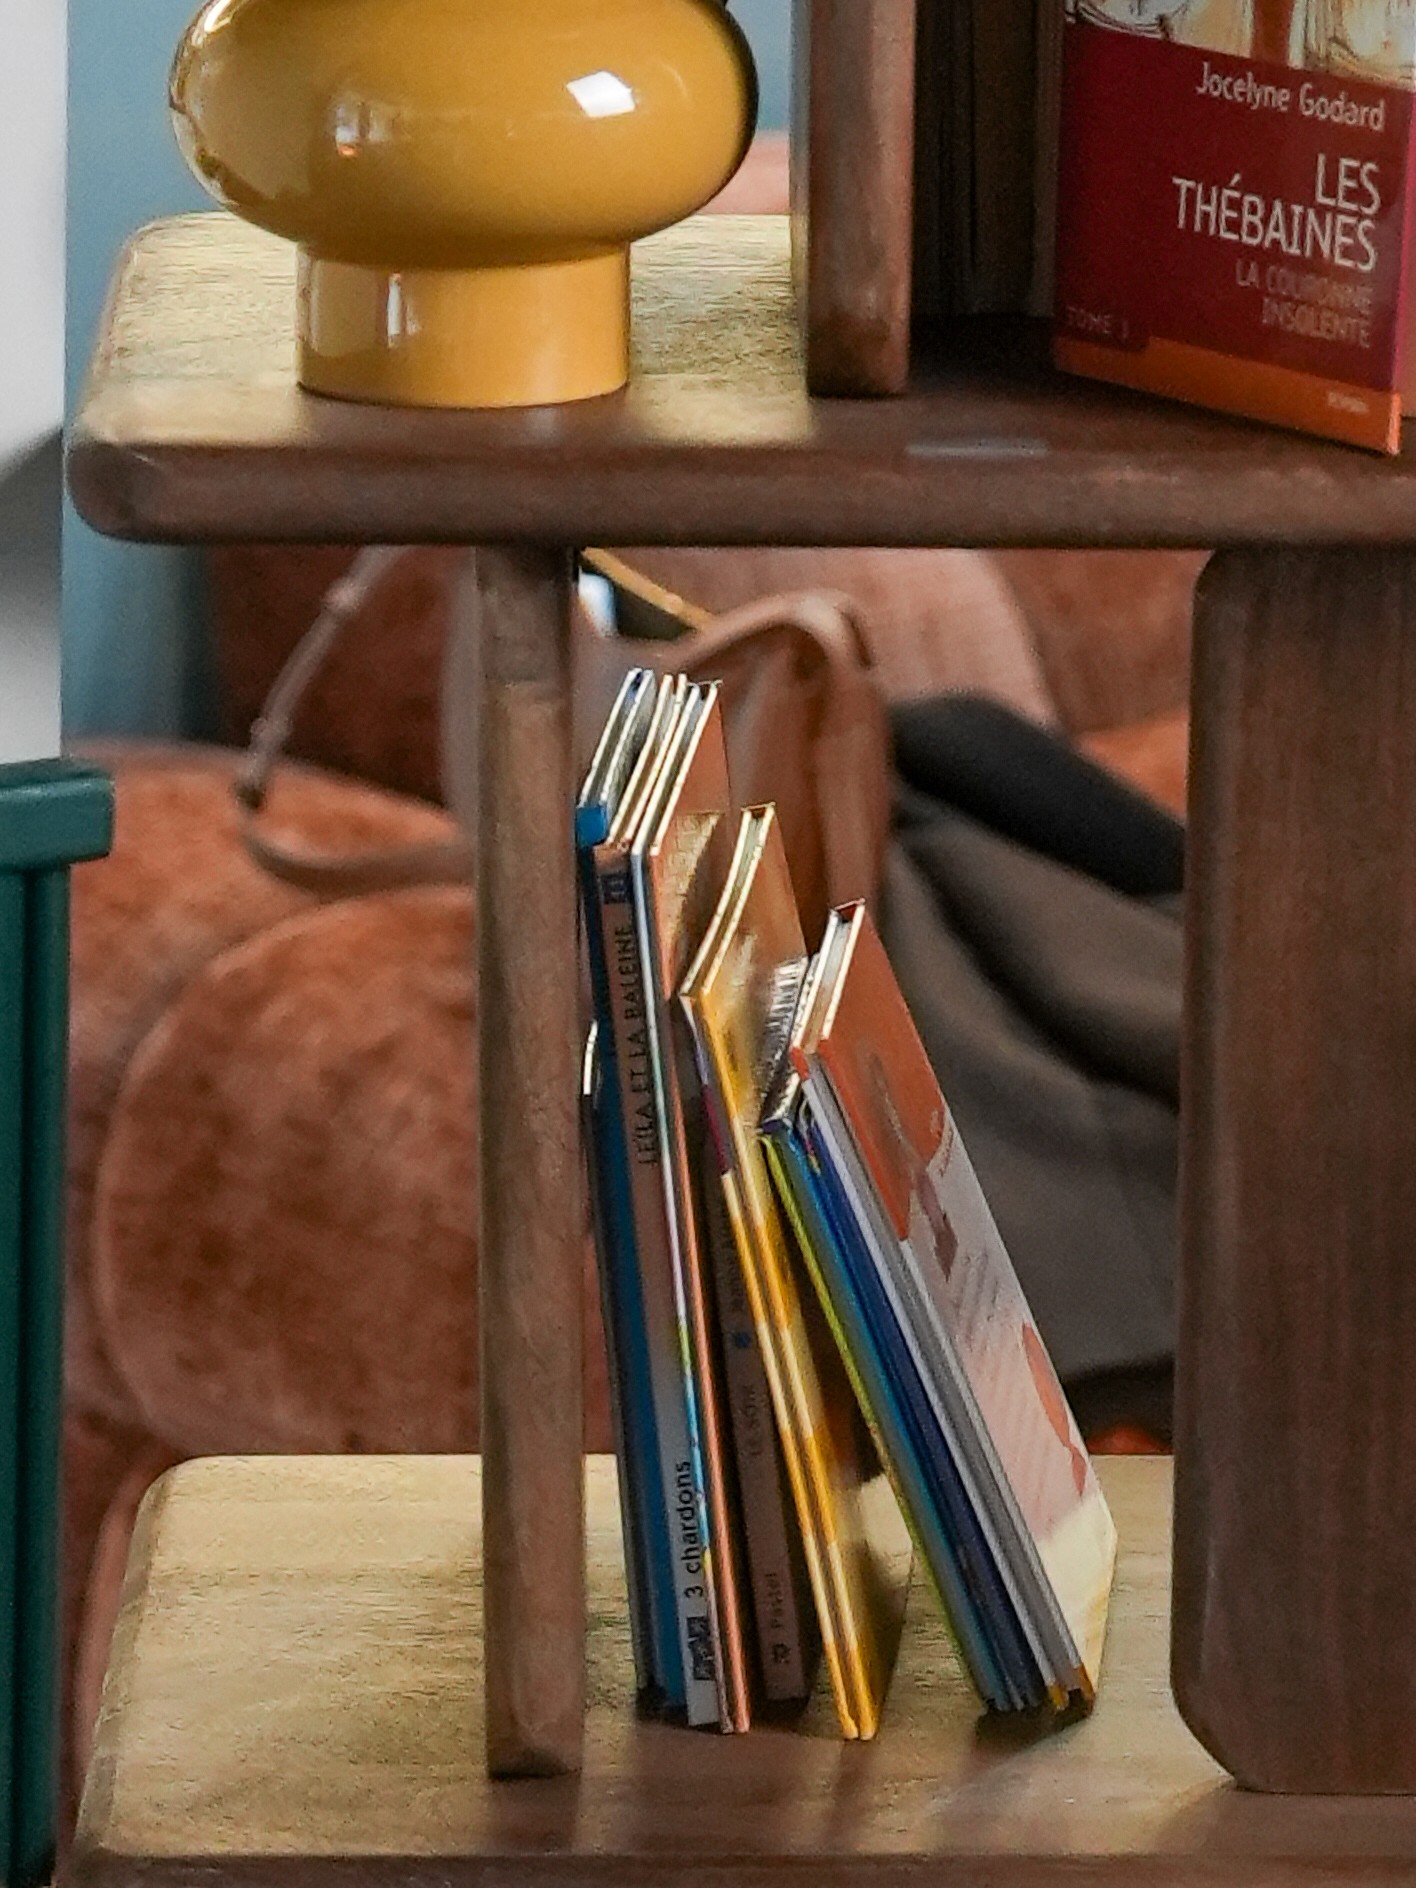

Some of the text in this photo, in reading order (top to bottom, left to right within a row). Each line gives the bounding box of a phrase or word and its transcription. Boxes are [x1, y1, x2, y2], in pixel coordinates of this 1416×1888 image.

[1196, 62, 1385, 133] Jocelyne Godard
[1315, 153, 1381, 215] LES
[1171, 173, 1378, 272] THÉBAINES
[1236, 258, 1260, 289] LA
[676, 1460, 704, 1600] 3 chardons
